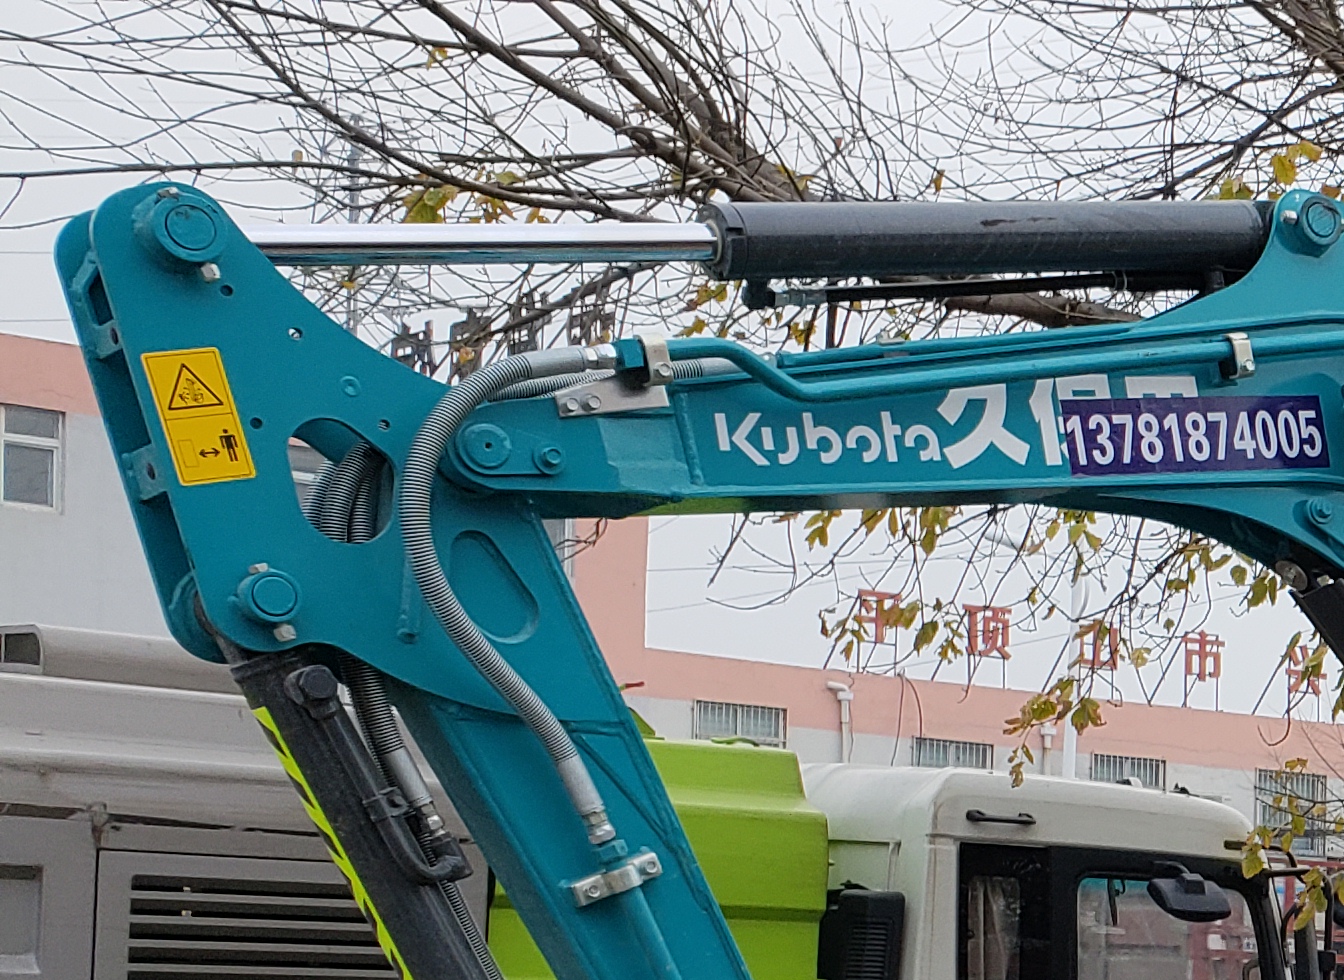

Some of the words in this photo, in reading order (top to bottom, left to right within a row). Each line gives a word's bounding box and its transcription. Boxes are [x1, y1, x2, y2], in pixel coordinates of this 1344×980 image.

[714, 411, 942, 467] Kubota
[937, 374, 1199, 469] 久保
[1066, 411, 1322, 466] 13781874005
